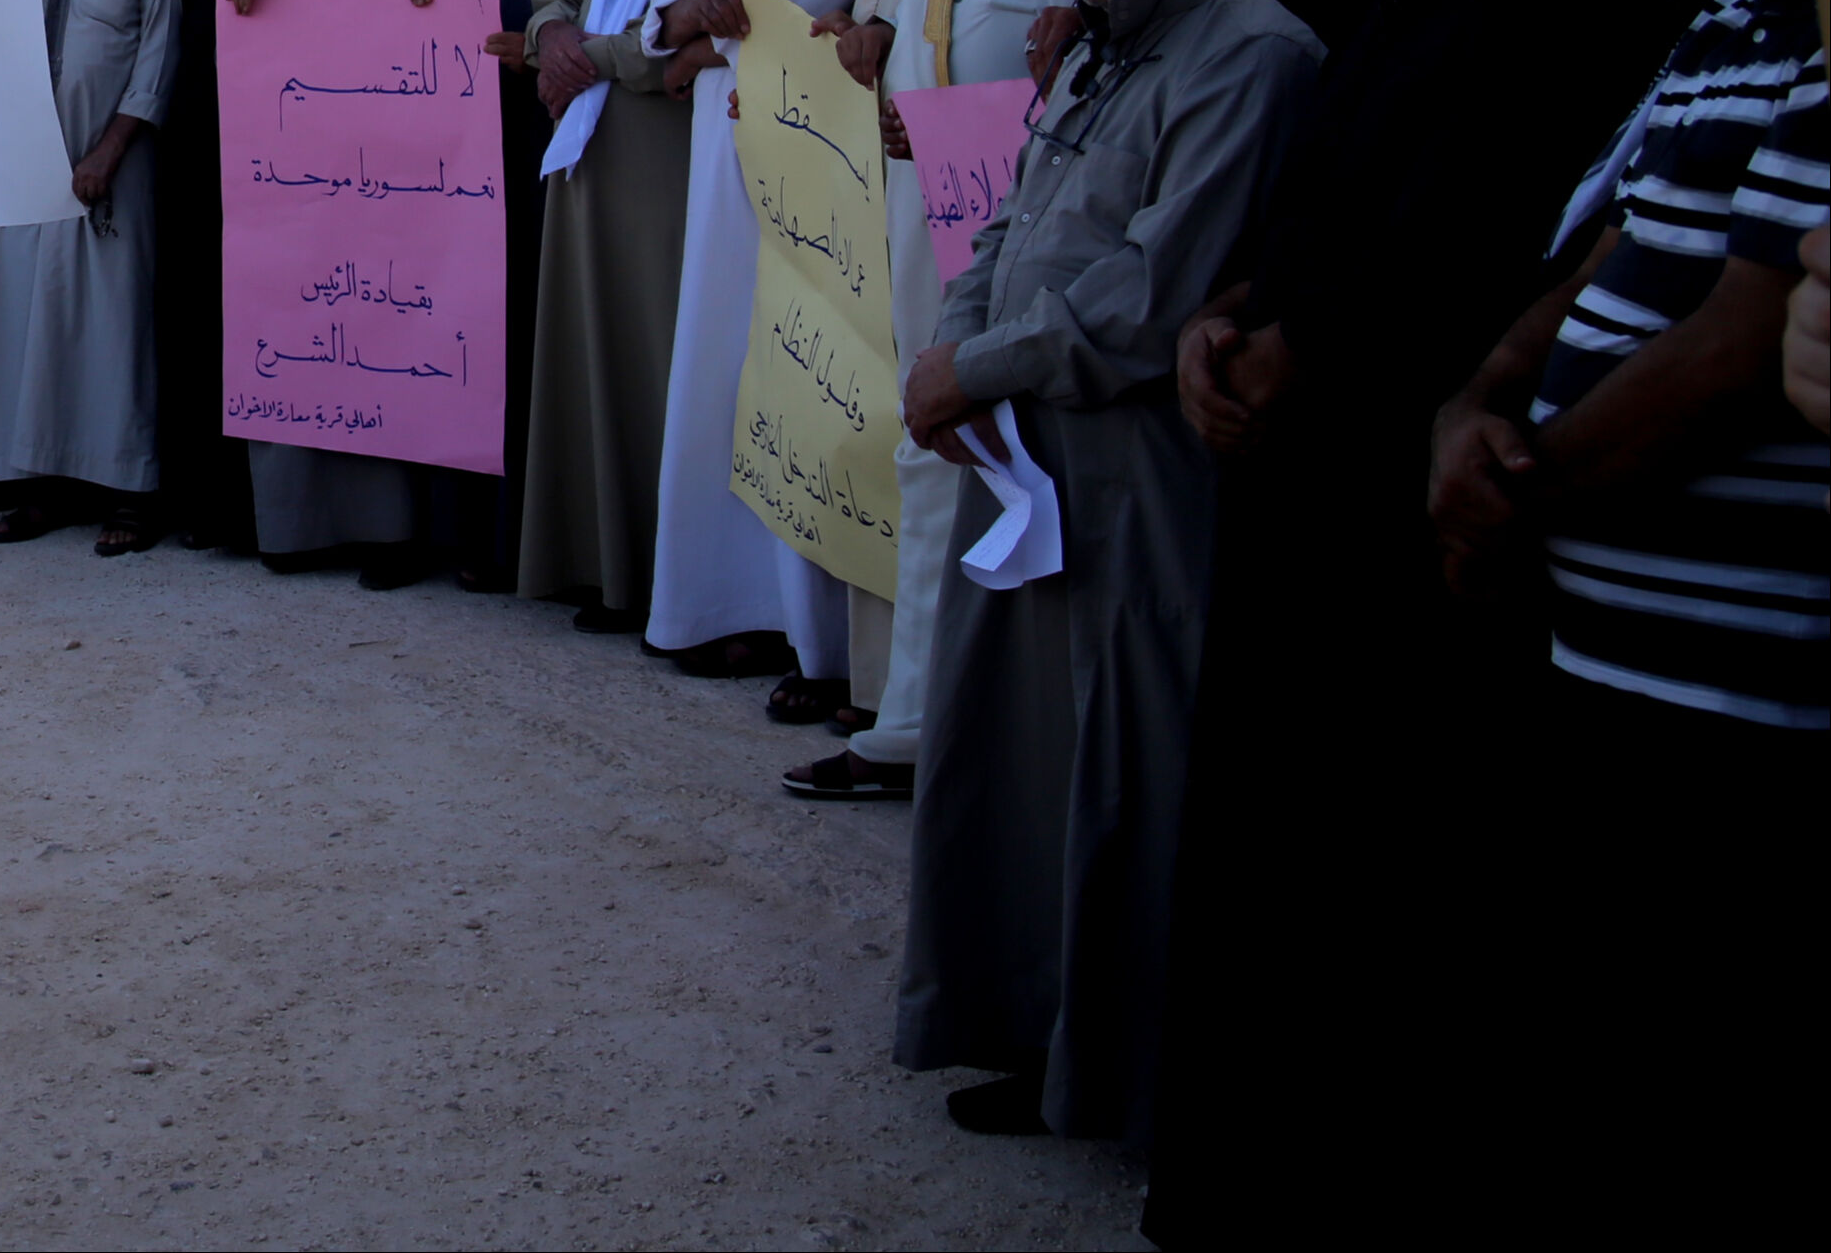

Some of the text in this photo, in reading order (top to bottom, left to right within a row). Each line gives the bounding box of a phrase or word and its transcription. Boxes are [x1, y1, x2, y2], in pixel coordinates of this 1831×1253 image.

[279, 38, 481, 131] لا للتقسيم
[773, 63, 870, 202] يسقط
[251, 147, 494, 200] نعم لسوريا موحدة
[300, 260, 433, 315] بقيادة الرئيس
[255, 323, 467, 387] أحمد الشرع
[770, 297, 824, 373] النظام
[275, 402, 311, 422] معارة
[315, 405, 343, 429] قرية
[345, 404, 383, 434] أهالي
[782, 437, 834, 510] التدخل
